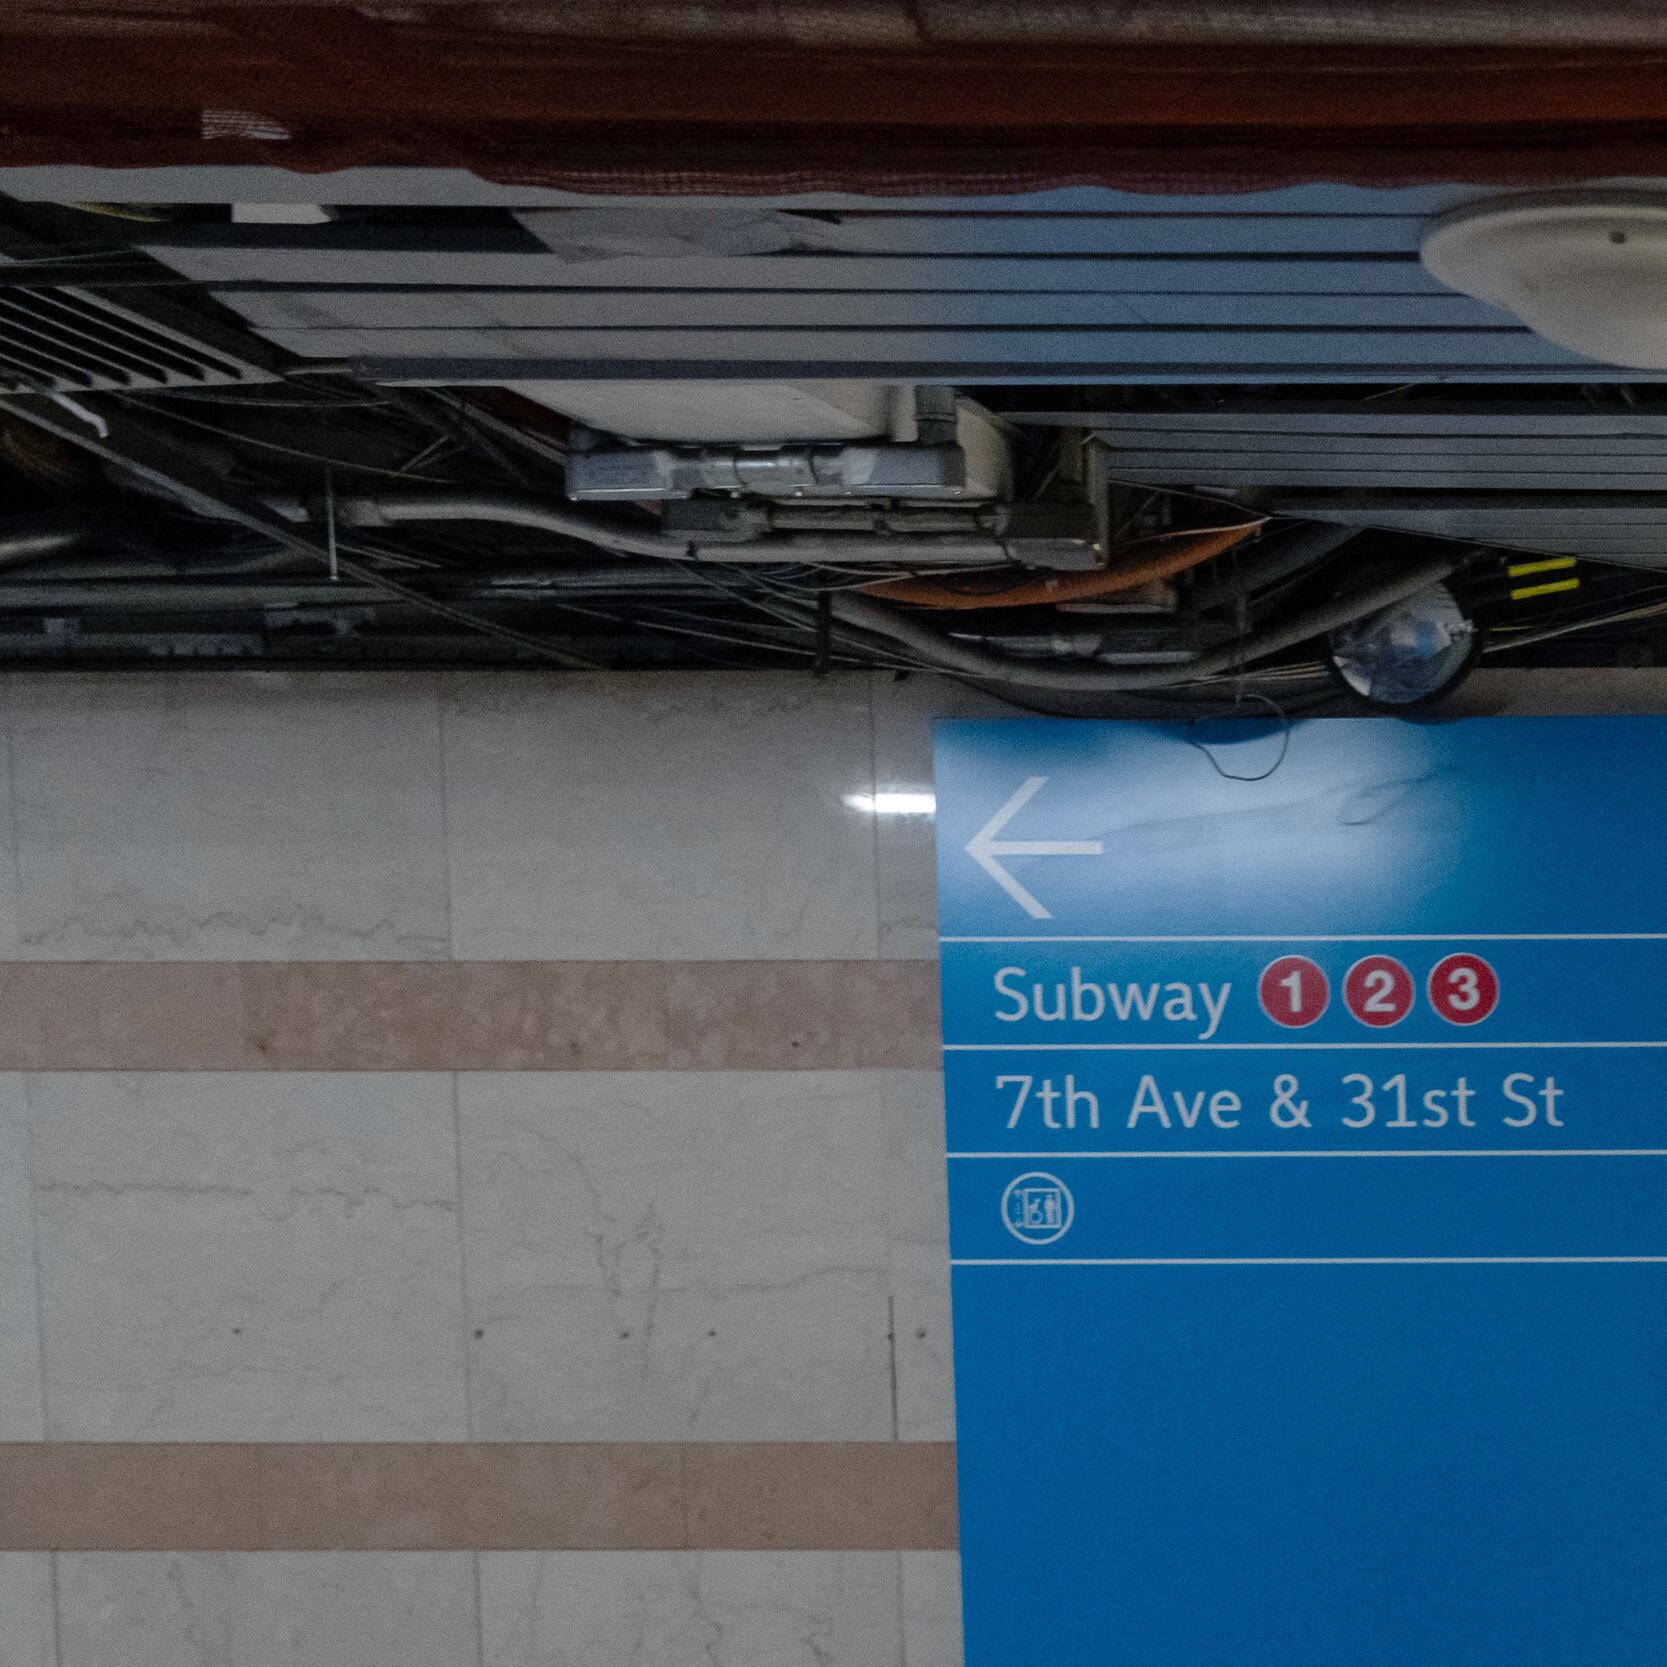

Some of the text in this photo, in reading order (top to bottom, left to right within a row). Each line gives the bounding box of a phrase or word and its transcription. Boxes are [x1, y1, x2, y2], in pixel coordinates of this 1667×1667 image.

[993, 965, 1481, 1041] Subway 1 2 3
[995, 1071, 1565, 1130] 7th Ave & 31st St
